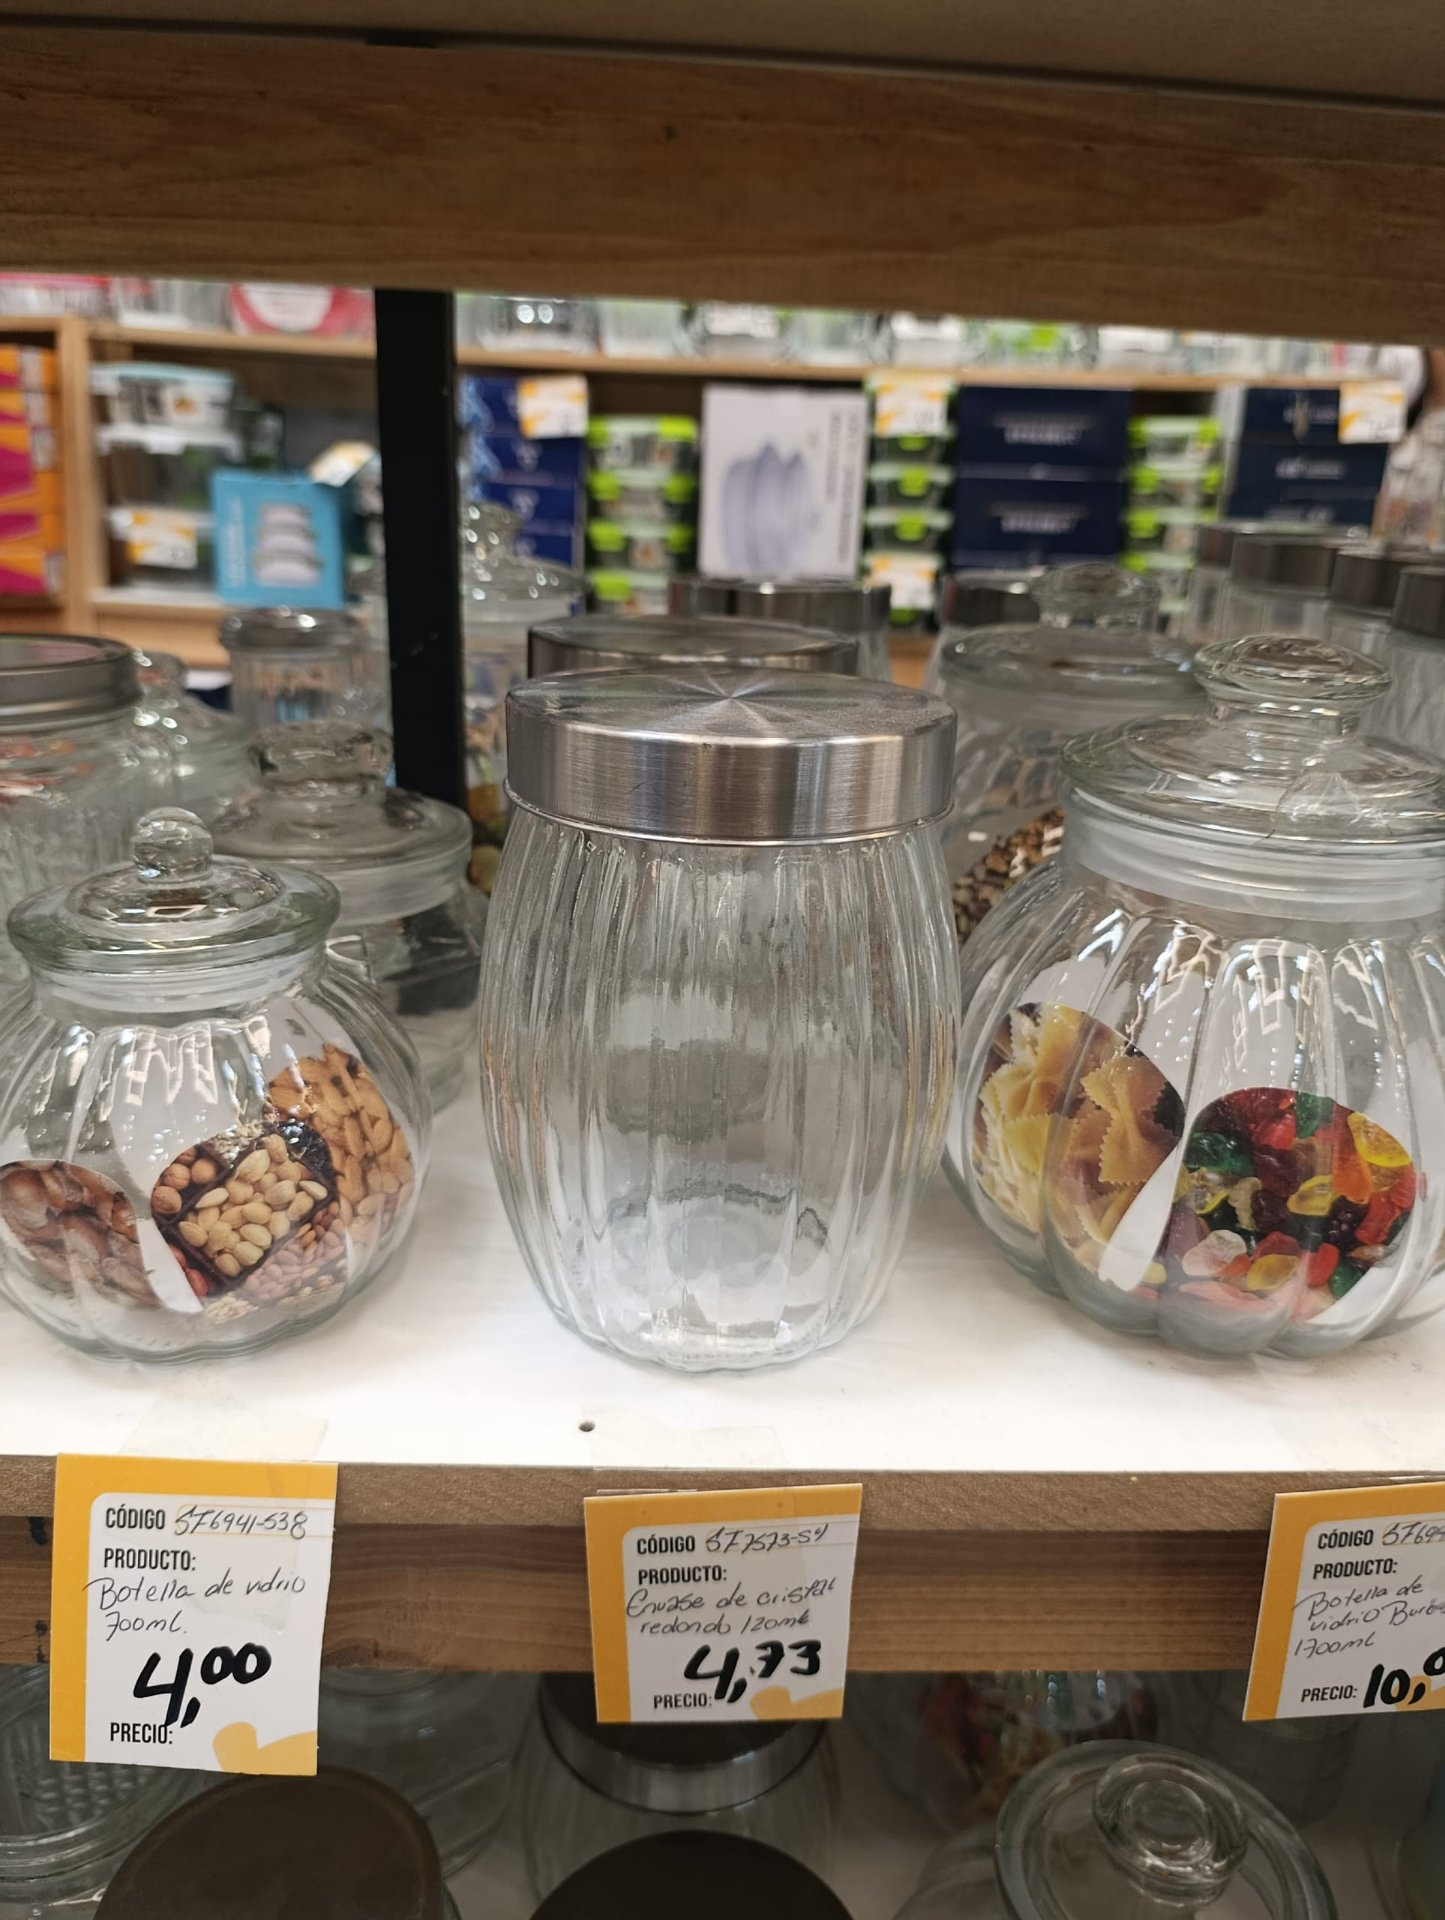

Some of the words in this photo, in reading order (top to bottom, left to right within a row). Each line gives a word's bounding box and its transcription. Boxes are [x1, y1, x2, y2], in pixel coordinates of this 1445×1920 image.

[105, 1503, 166, 1530] CÓDIGO
[637, 1534, 696, 1555] CÓDIGO
[1317, 1528, 1374, 1550] CÓDIGO
[104, 1548, 197, 1572] PRODUCTO:
[1312, 1557, 1398, 1580] PRODUCTO:
[638, 1565, 728, 1586] PRODUCTO:
[81, 1576, 195, 1611] Botella
[204, 1567, 232, 1598] de
[716, 1581, 748, 1609] de
[1291, 1588, 1389, 1622] Botella
[1395, 1575, 1424, 1599] de
[133, 1642, 272, 1729] 4,00
[1300, 1684, 1358, 1703] PRECIO:
[653, 1693, 713, 1710] PRECIO:
[110, 1722, 174, 1745] PRECIO:
